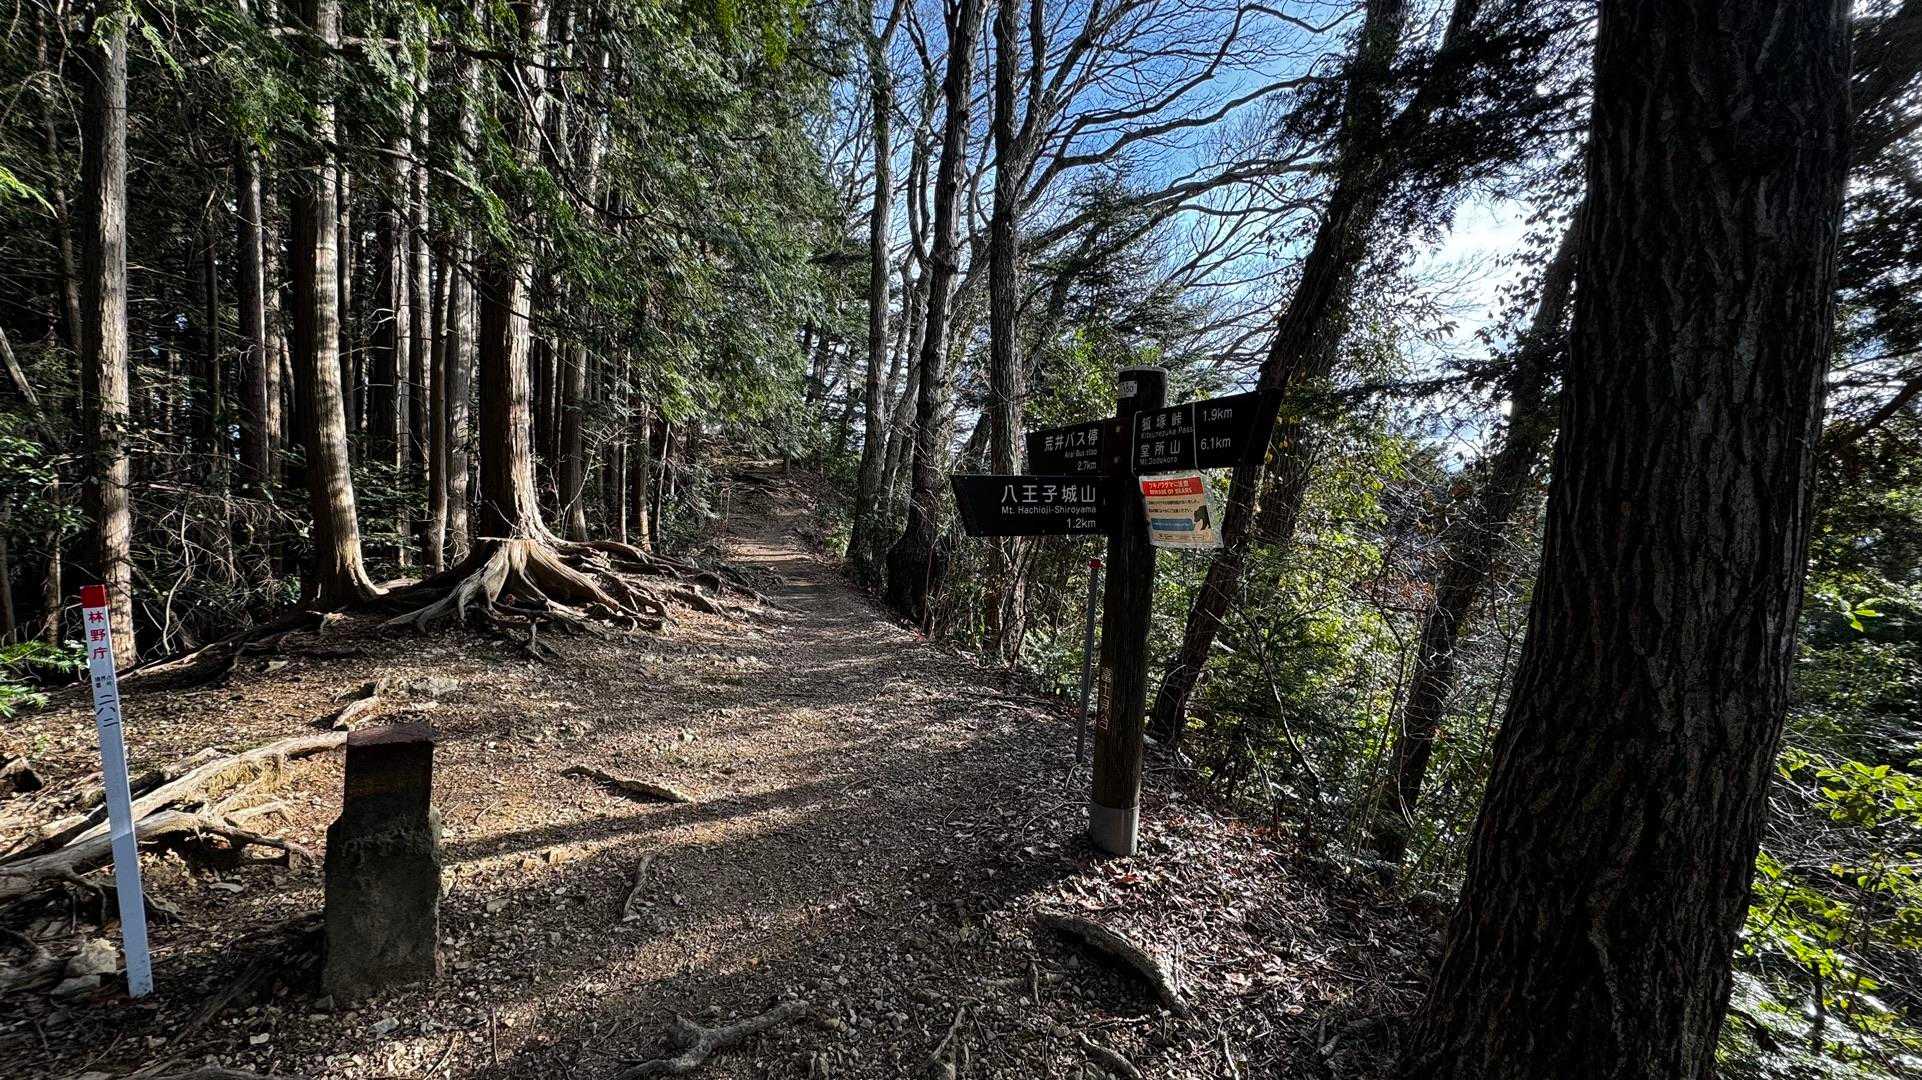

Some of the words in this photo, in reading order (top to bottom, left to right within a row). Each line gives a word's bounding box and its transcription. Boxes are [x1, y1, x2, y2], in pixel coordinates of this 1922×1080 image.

[1202, 408, 1233, 422] 1.9km
[1043, 428, 1098, 452] 荒井バス停
[1200, 437, 1232, 450] 6.1km
[1139, 440, 1181, 458] 堂所山
[1001, 484, 1096, 503] 八王子城山
[1001, 506, 1015, 515] Mt.
[1018, 505, 1096, 515] Hachioji-Shiroyama
[1067, 518, 1097, 529] 1.2km
[88, 610, 108, 660] 林野庁
